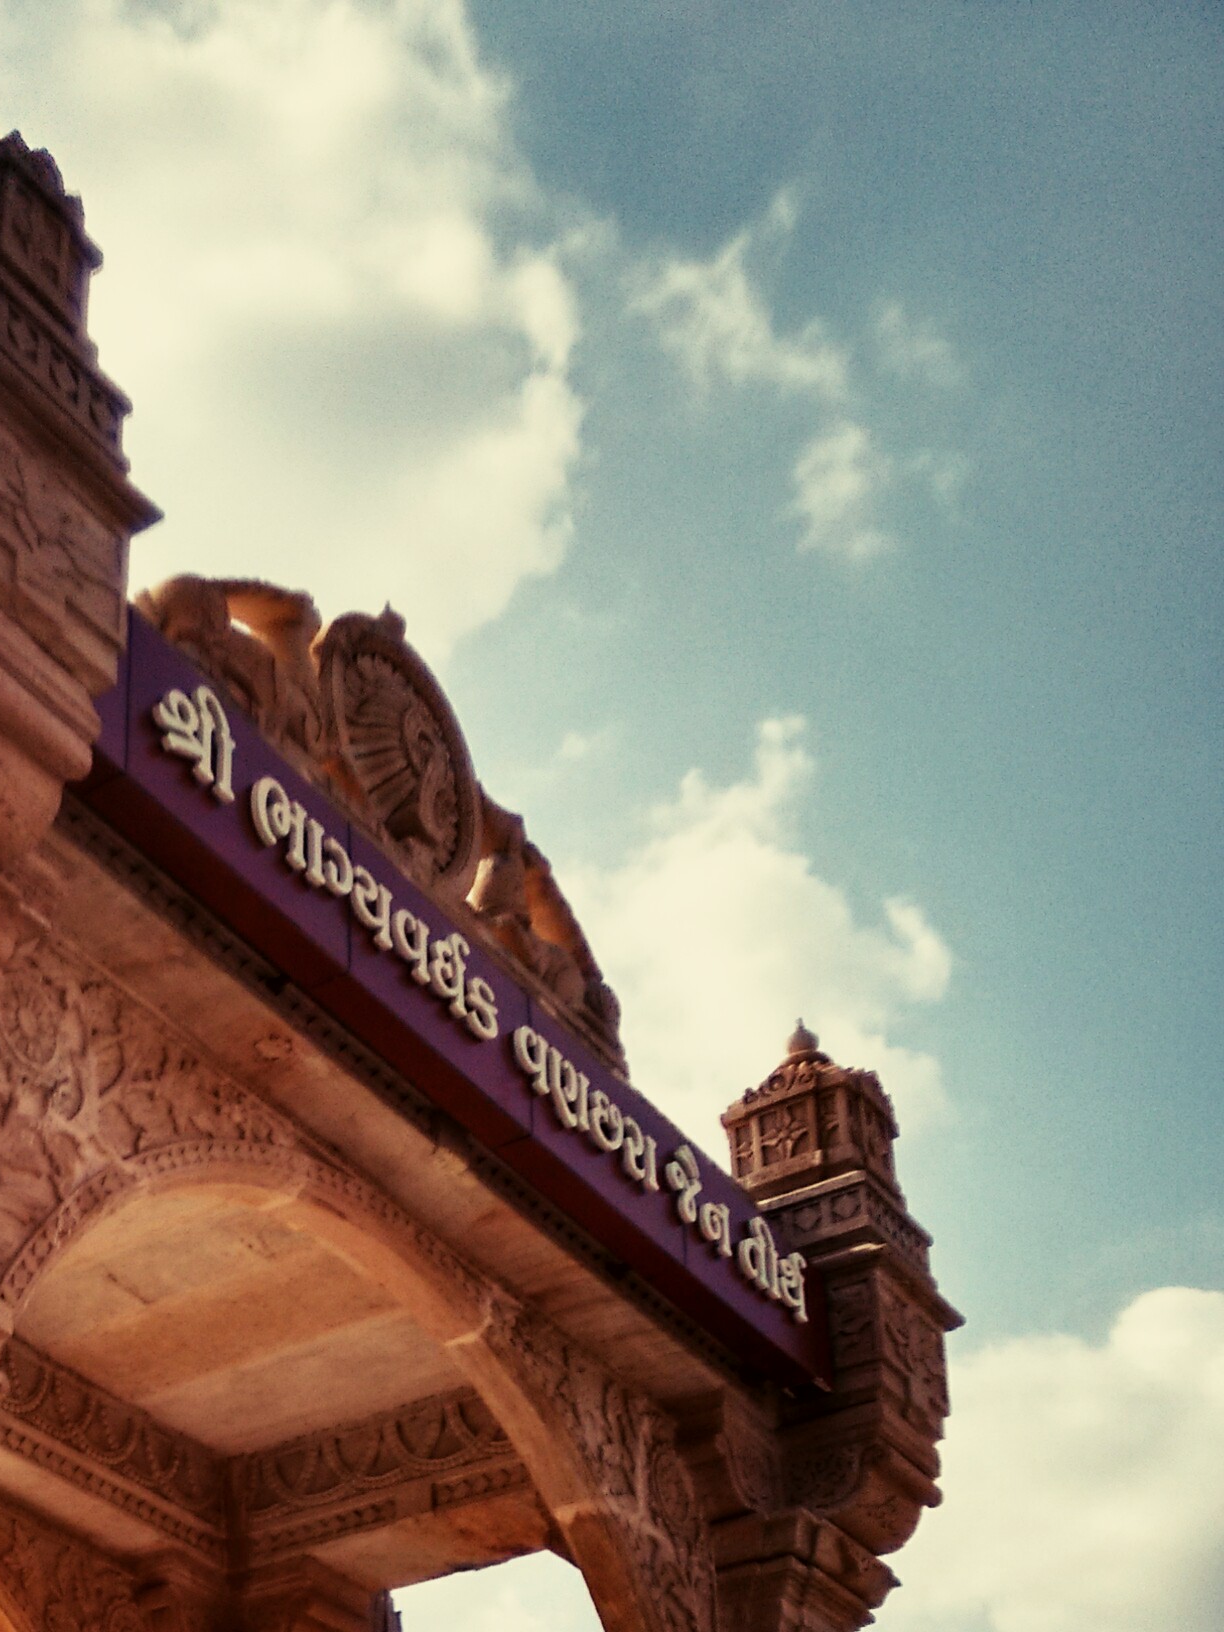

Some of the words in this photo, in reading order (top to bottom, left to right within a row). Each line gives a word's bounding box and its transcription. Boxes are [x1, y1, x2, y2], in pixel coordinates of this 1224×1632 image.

[152, 685, 236, 802] શ્રી
[250, 776, 498, 1040] ભાગ્યવર્ધક
[514, 1025, 659, 1192] વણછરા
[738, 1216, 808, 1324] તીર્થ
